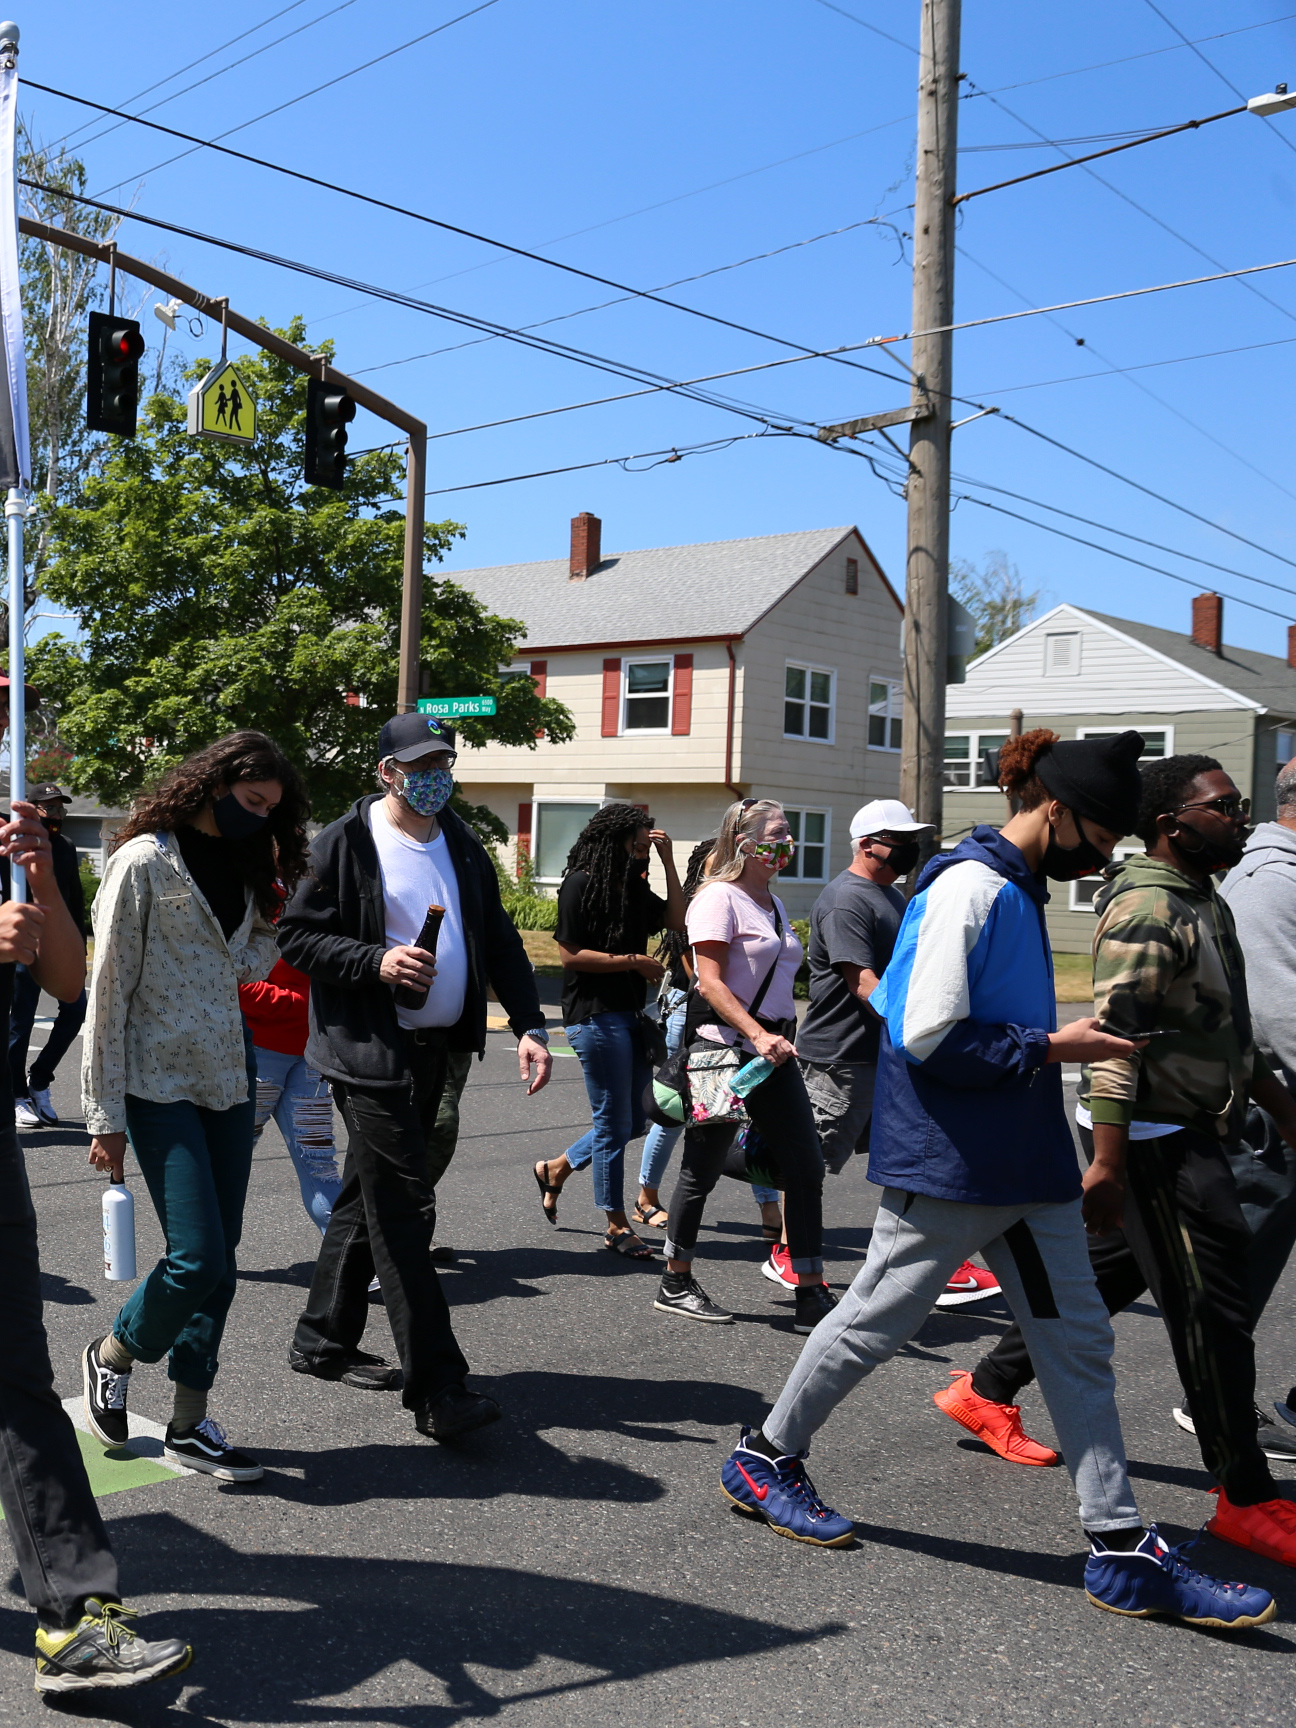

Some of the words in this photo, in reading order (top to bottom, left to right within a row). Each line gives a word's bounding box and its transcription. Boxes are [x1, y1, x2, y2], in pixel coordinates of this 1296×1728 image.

[420, 706, 424, 714] N
[426, 702, 449, 714] Rosa
[452, 701, 480, 713] Parks
